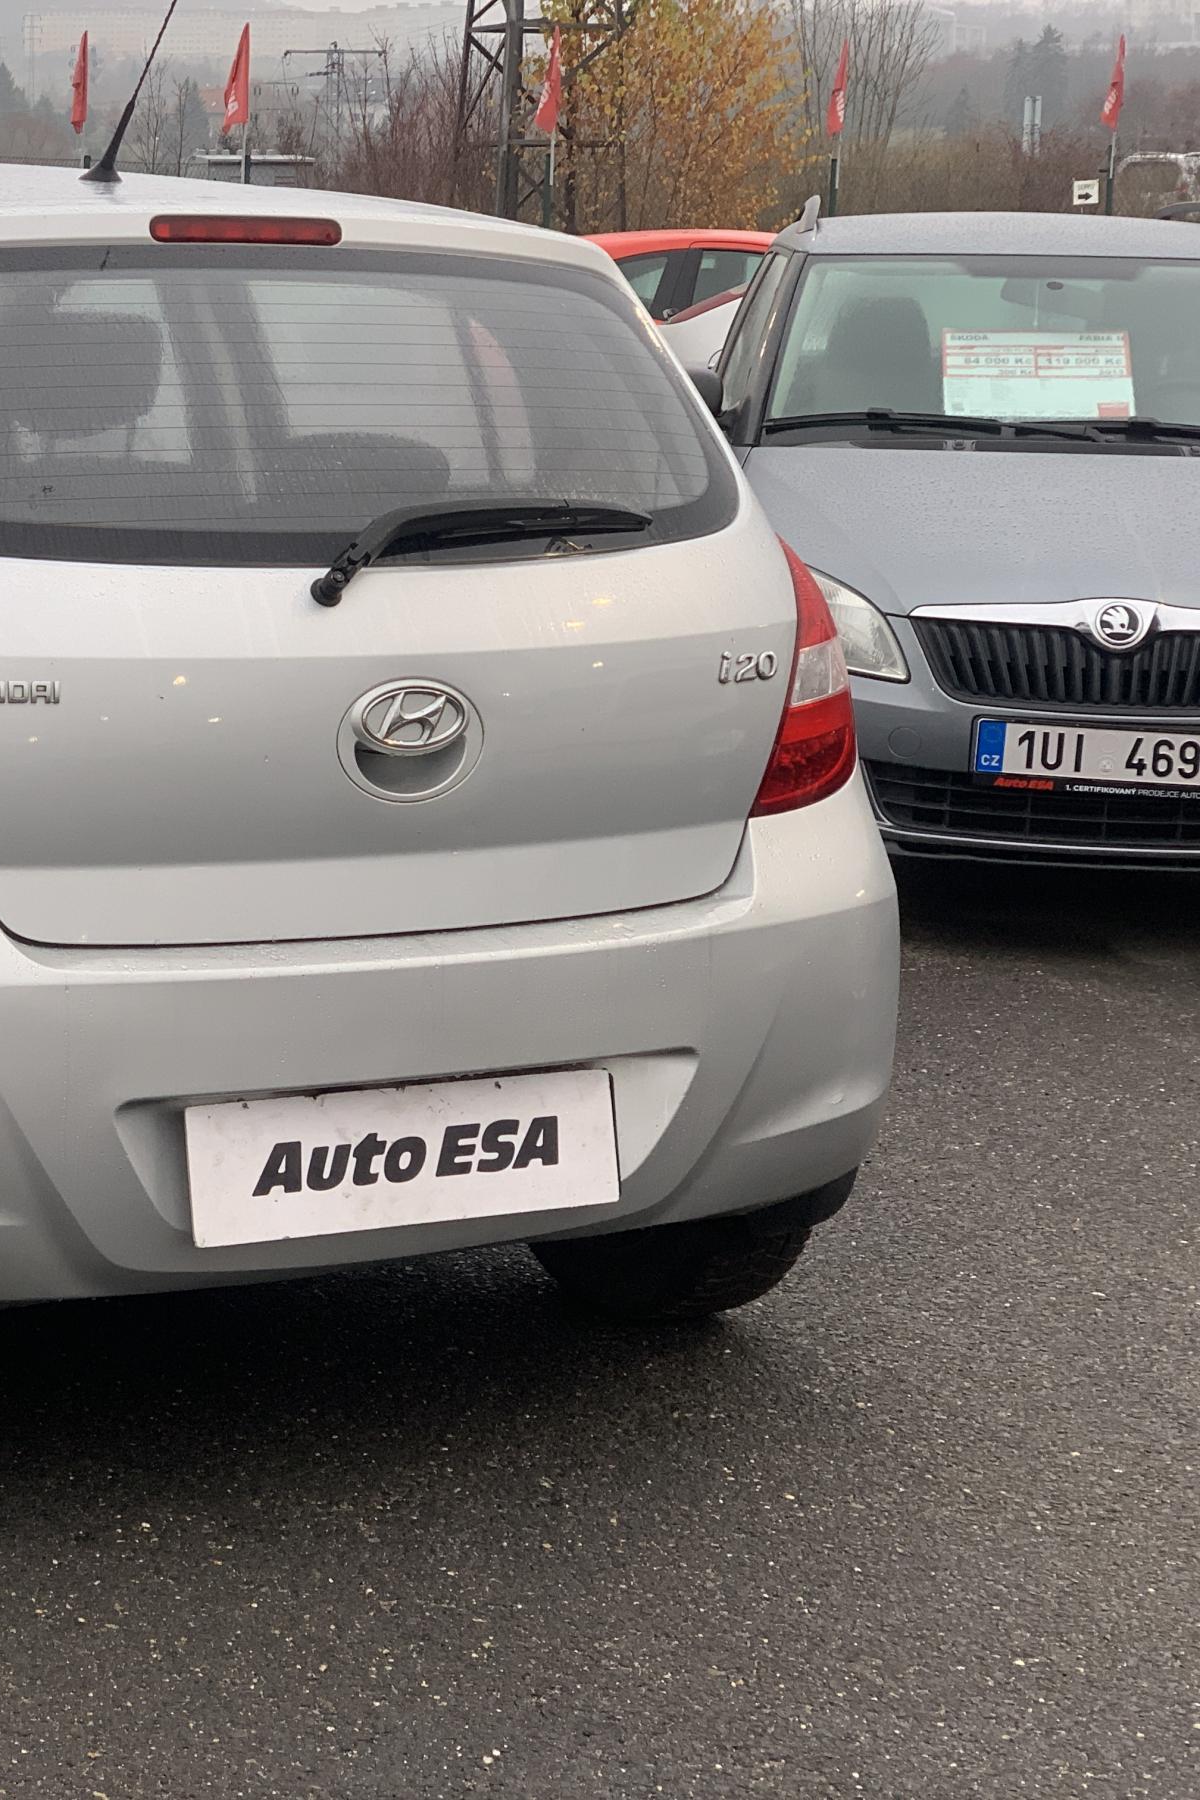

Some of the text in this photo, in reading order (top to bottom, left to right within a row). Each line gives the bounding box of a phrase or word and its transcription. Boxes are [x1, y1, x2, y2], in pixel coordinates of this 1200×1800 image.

[718, 651, 777, 684] i20
[980, 754, 1001, 767] CZ
[1018, 730, 1200, 779] 1UI 469
[993, 777, 1054, 791] Auto ESA
[1073, 784, 1137, 795] CERTIFIKOVANÝ
[1138, 788, 1179, 798] PRODEJCE
[252, 1116, 559, 1197] Auto ESA
